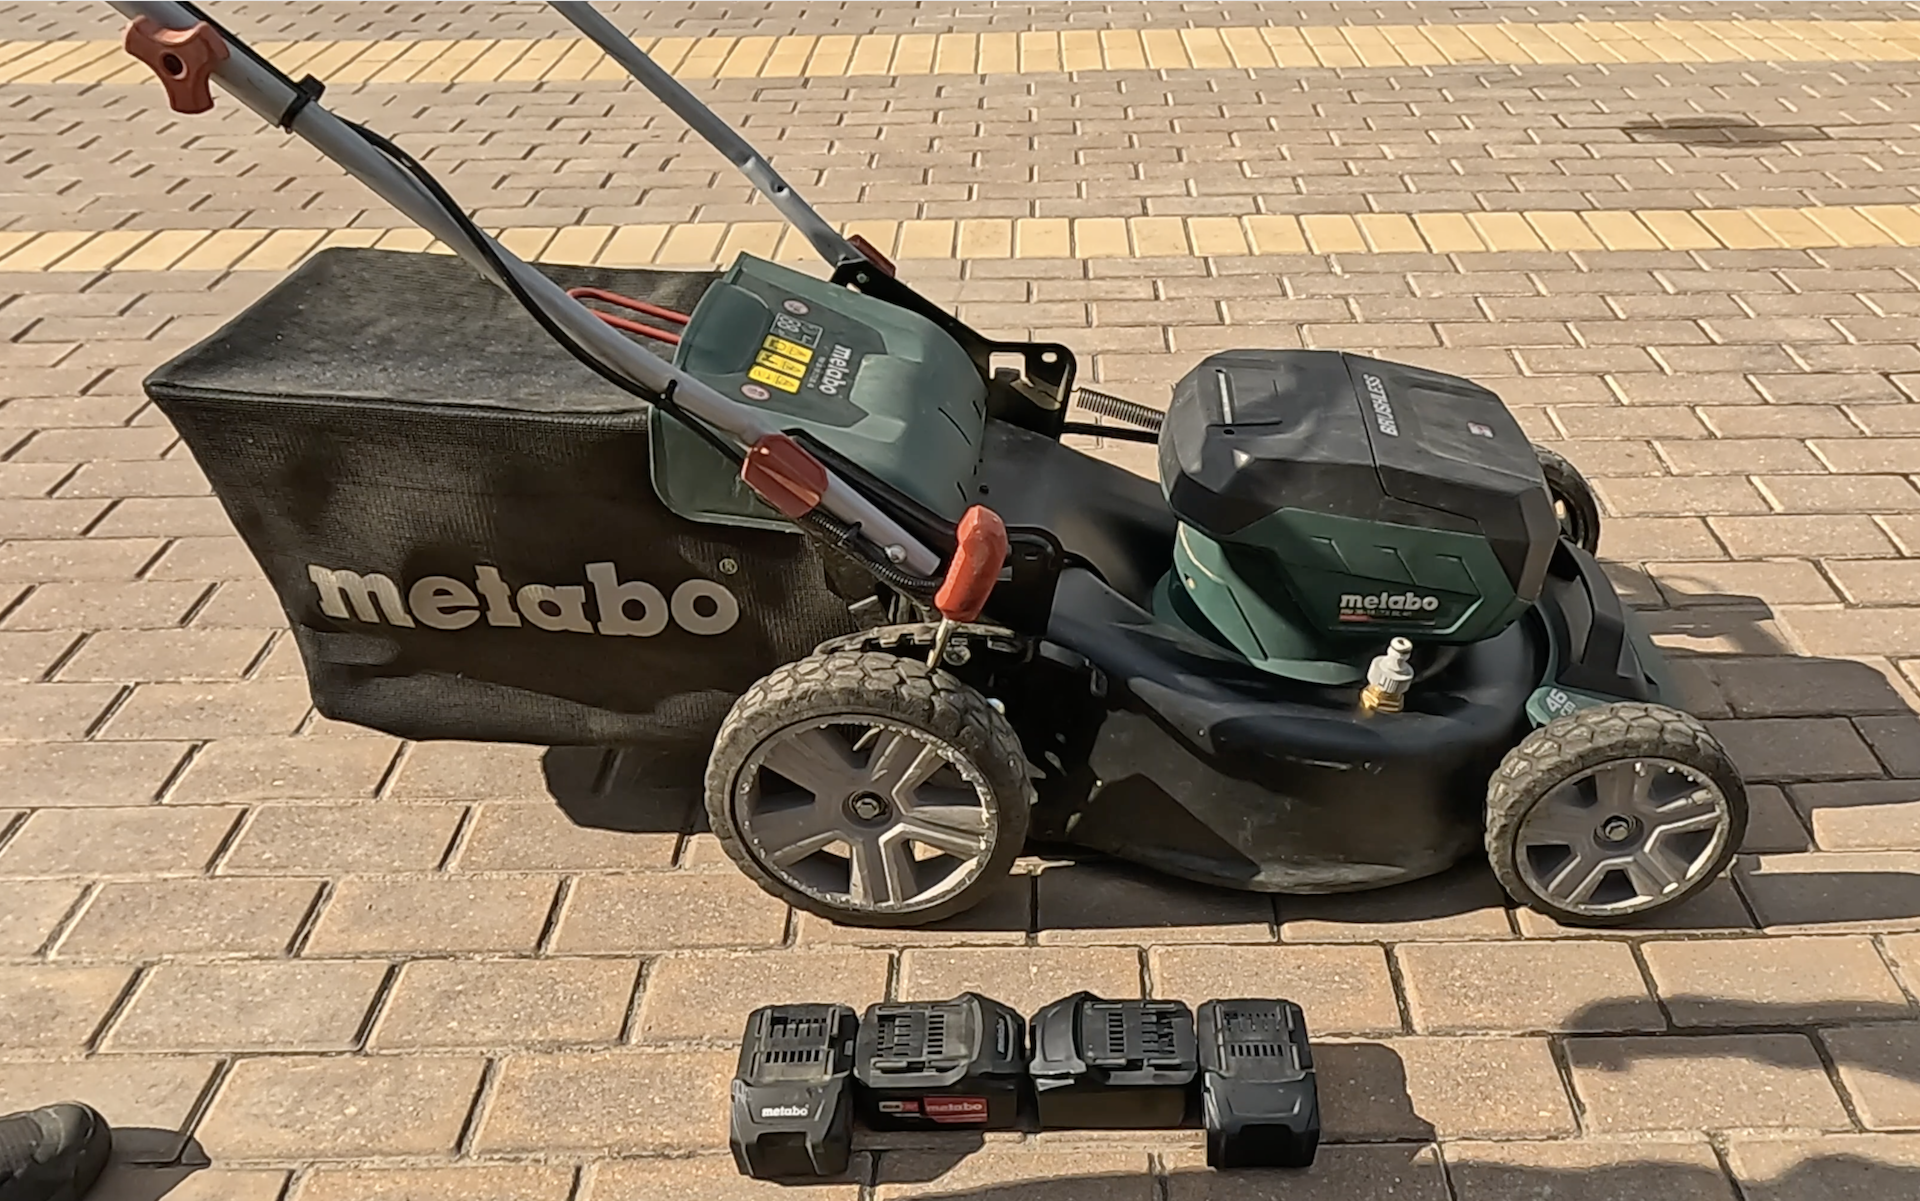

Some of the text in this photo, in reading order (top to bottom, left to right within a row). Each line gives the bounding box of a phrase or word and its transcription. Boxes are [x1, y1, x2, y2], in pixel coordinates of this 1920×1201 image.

[818, 344, 853, 395] metabo
[1363, 374, 1399, 437] BRUSHLESS
[308, 561, 740, 638] metabo
[1339, 591, 1439, 611] metabo
[1545, 688, 1568, 713] 46
[761, 1105, 808, 1118] metabo
[926, 1101, 984, 1112] metabo
